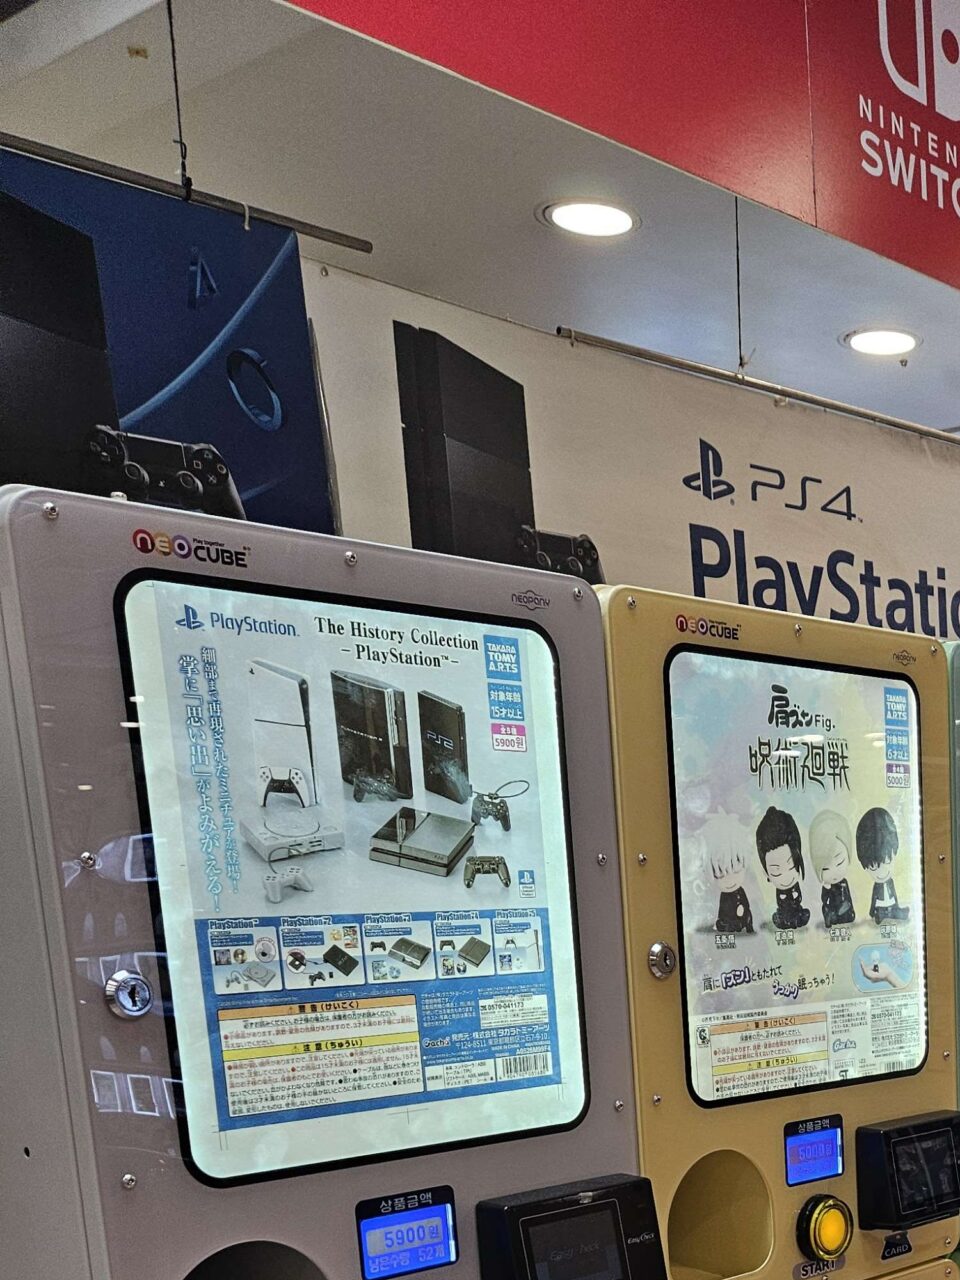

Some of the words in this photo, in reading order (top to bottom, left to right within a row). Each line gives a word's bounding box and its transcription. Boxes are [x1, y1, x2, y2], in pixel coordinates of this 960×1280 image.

[749, 462, 857, 522] PS4
[210, 612, 298, 637] PlayStation
[313, 616, 345, 636] The
[350, 621, 405, 645] History
[410, 627, 480, 652] Collection
[486, 643, 517, 655] TAKARA
[487, 652, 517, 664] TOMY
[886, 701, 907, 712] TOMY
[426, 729, 454, 750] PS2
[494, 737, 525, 749] 5900원
[379, 1191, 433, 1213] 상품금액
[884, 1244, 909, 1258] CARD
[801, 1260, 837, 1280] START
